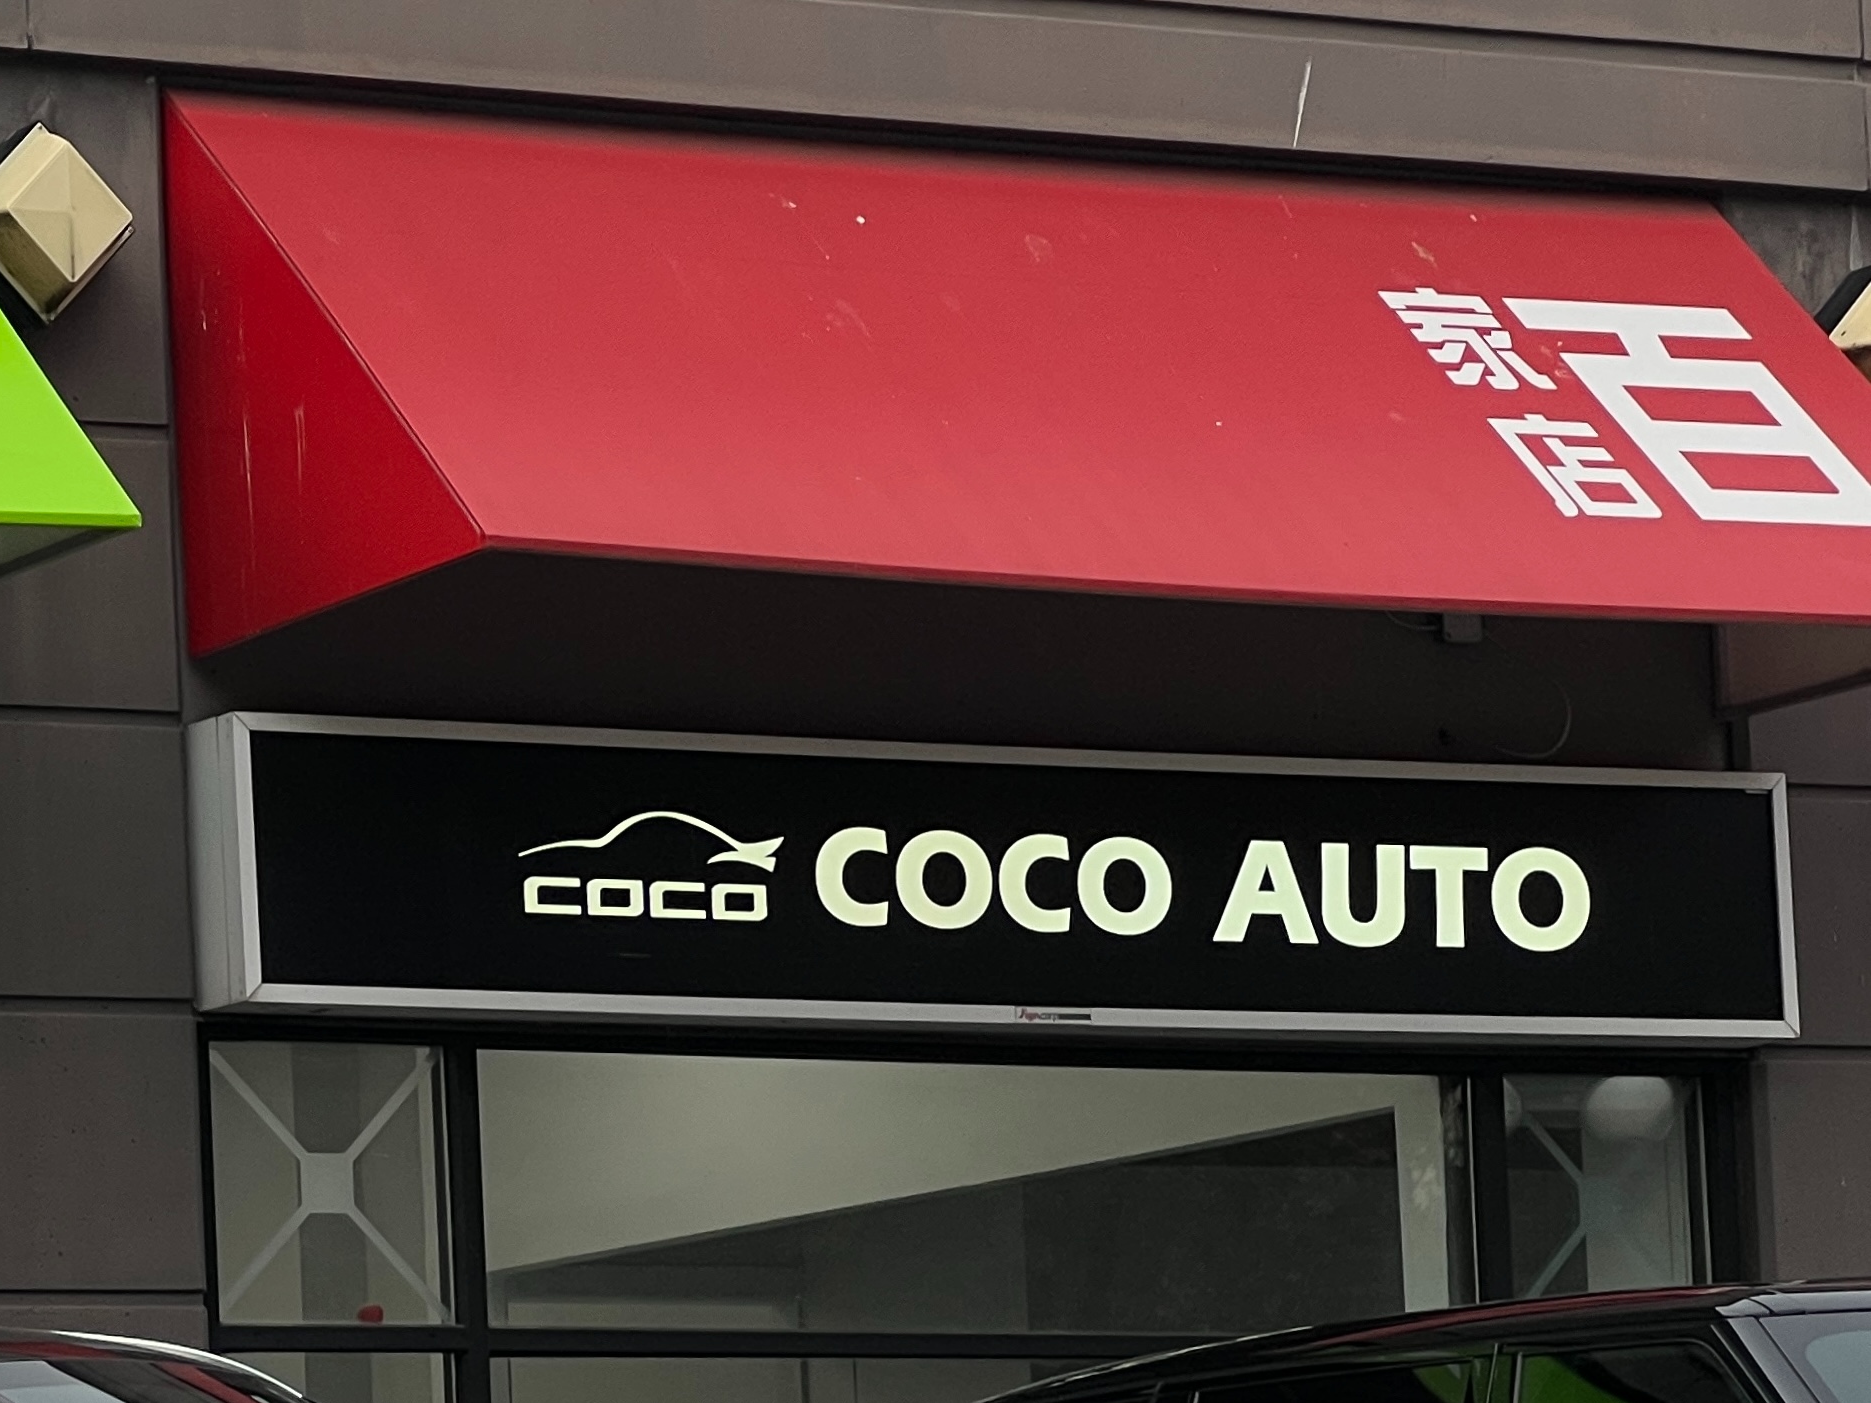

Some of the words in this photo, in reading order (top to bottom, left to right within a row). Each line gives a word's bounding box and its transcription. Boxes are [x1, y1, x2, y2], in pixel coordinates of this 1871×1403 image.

[523, 875, 769, 922] COCO
[815, 826, 1174, 936] COCO
[1213, 839, 1591, 952] AUTO
